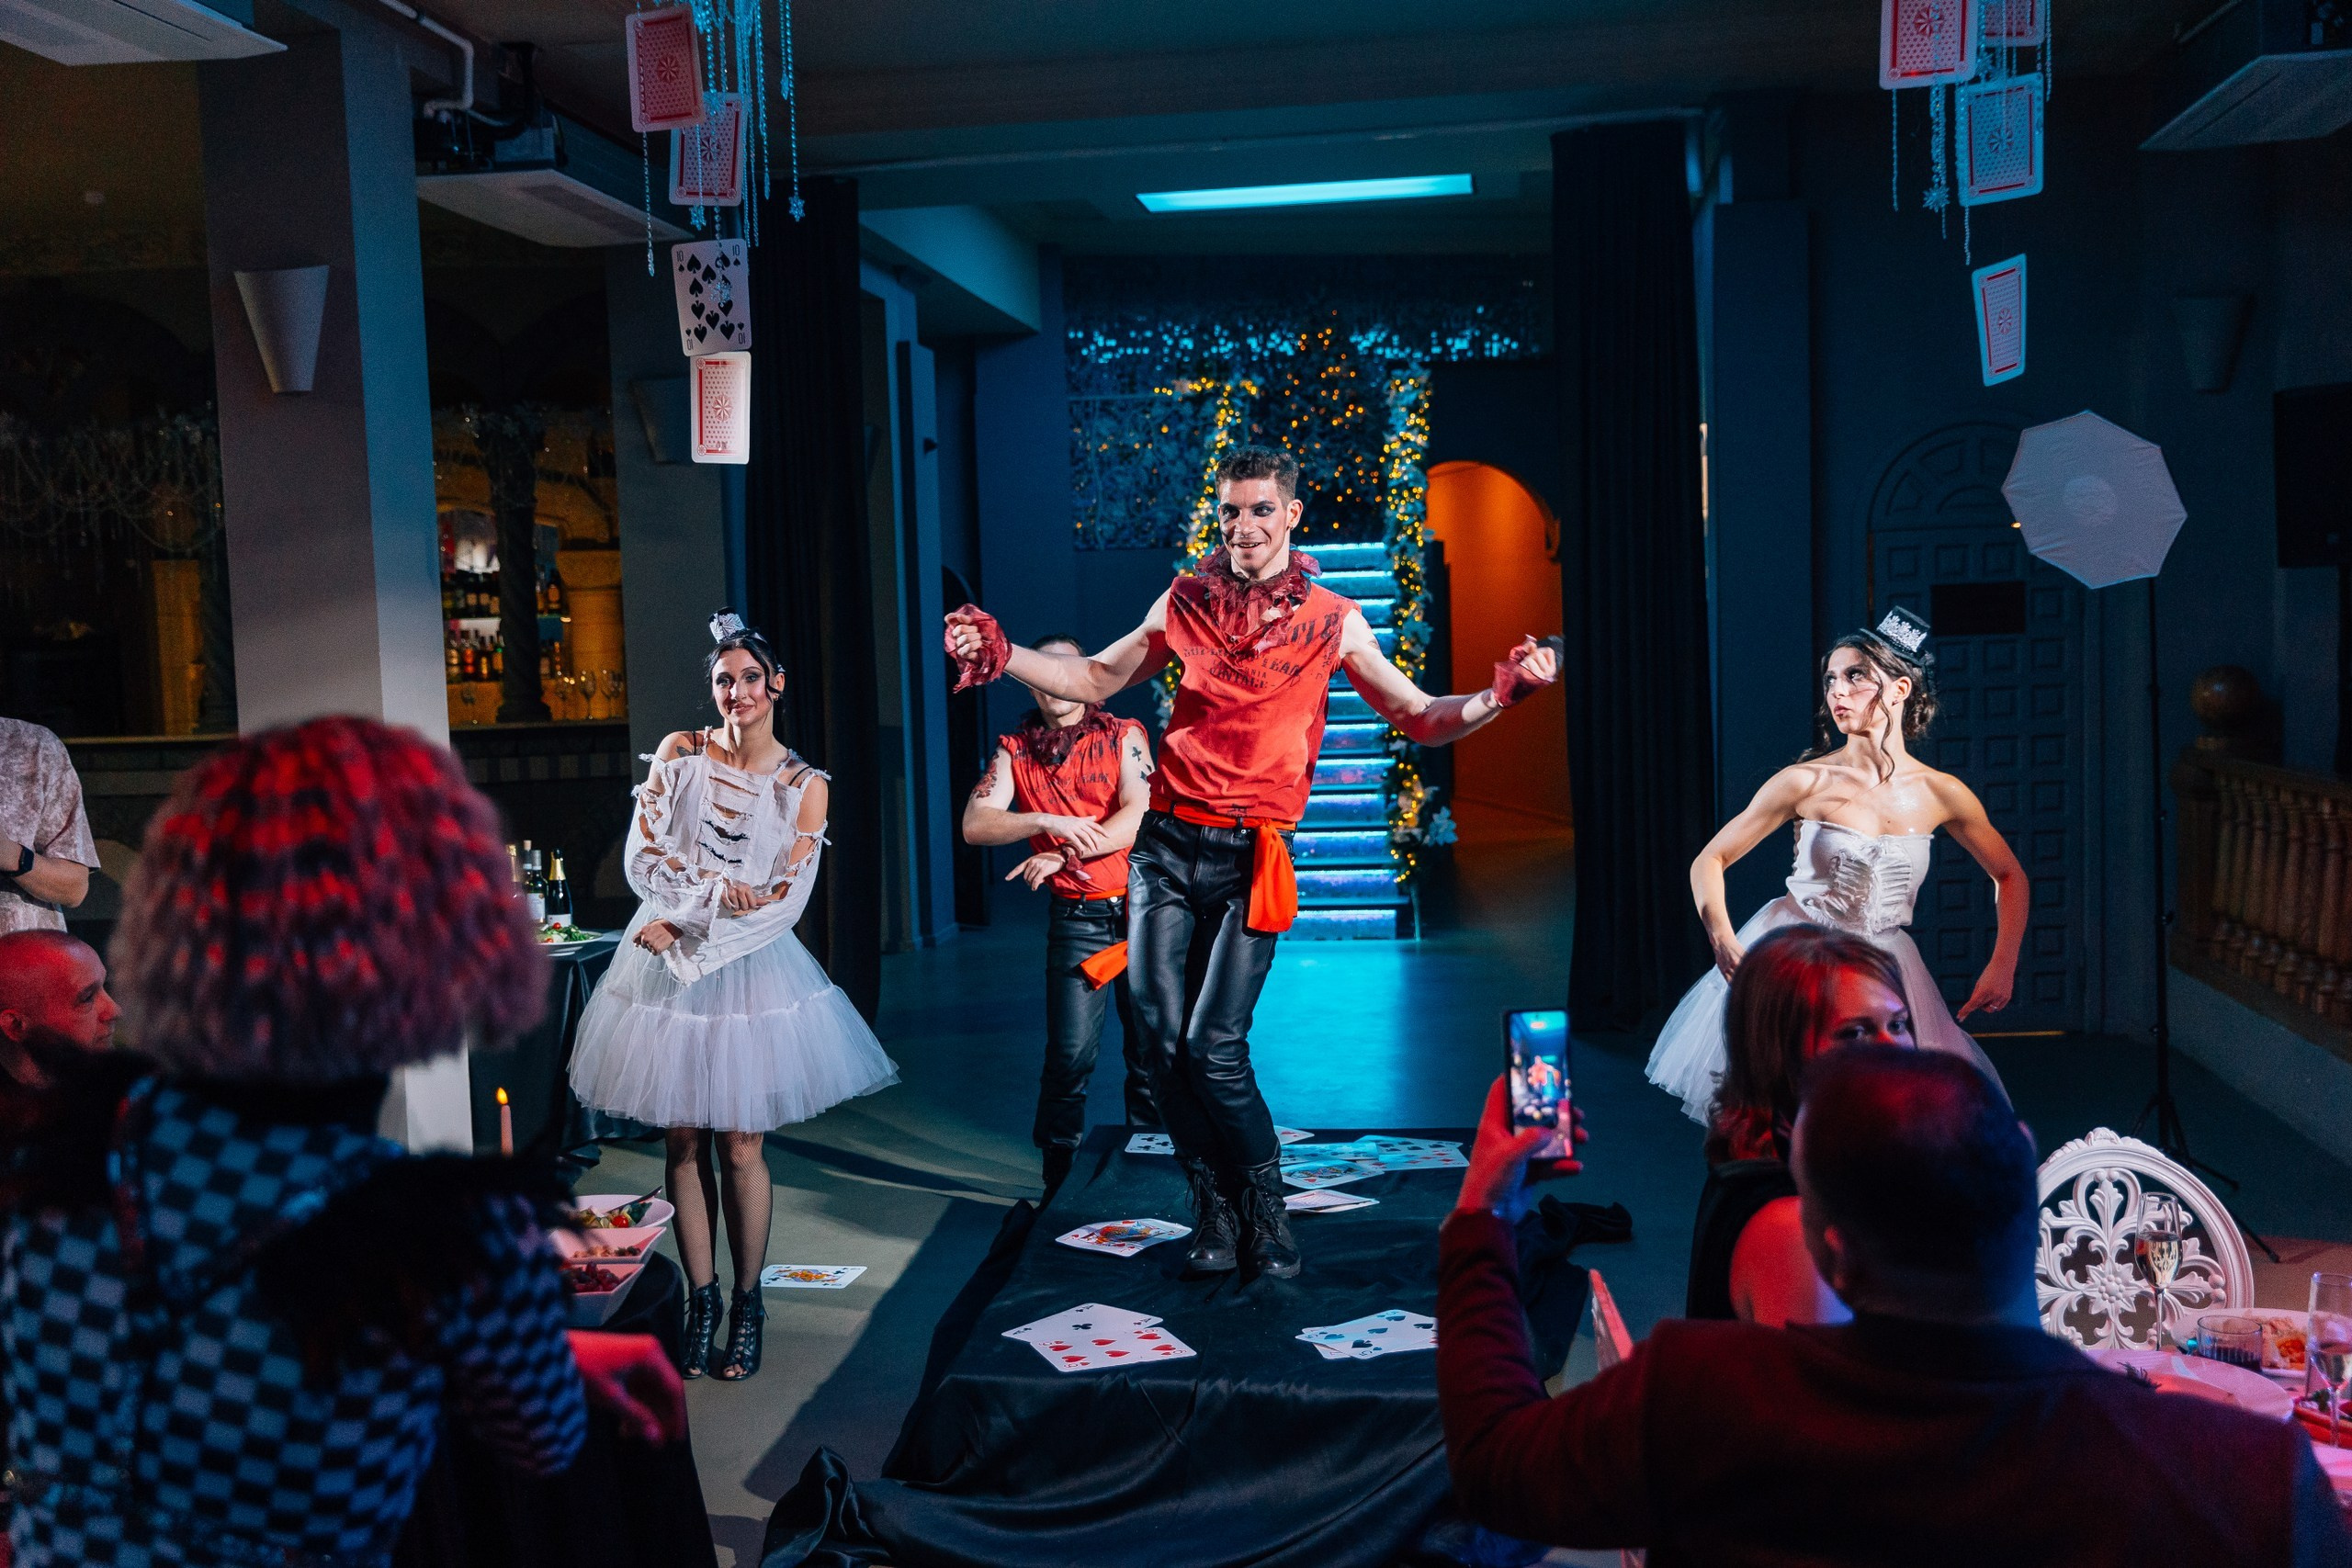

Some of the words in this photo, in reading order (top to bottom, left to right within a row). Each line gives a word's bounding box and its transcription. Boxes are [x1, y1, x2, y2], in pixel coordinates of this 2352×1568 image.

[732, 244, 741, 256] 10
[686, 338, 694, 351] 10
[738, 333, 746, 344] 10
